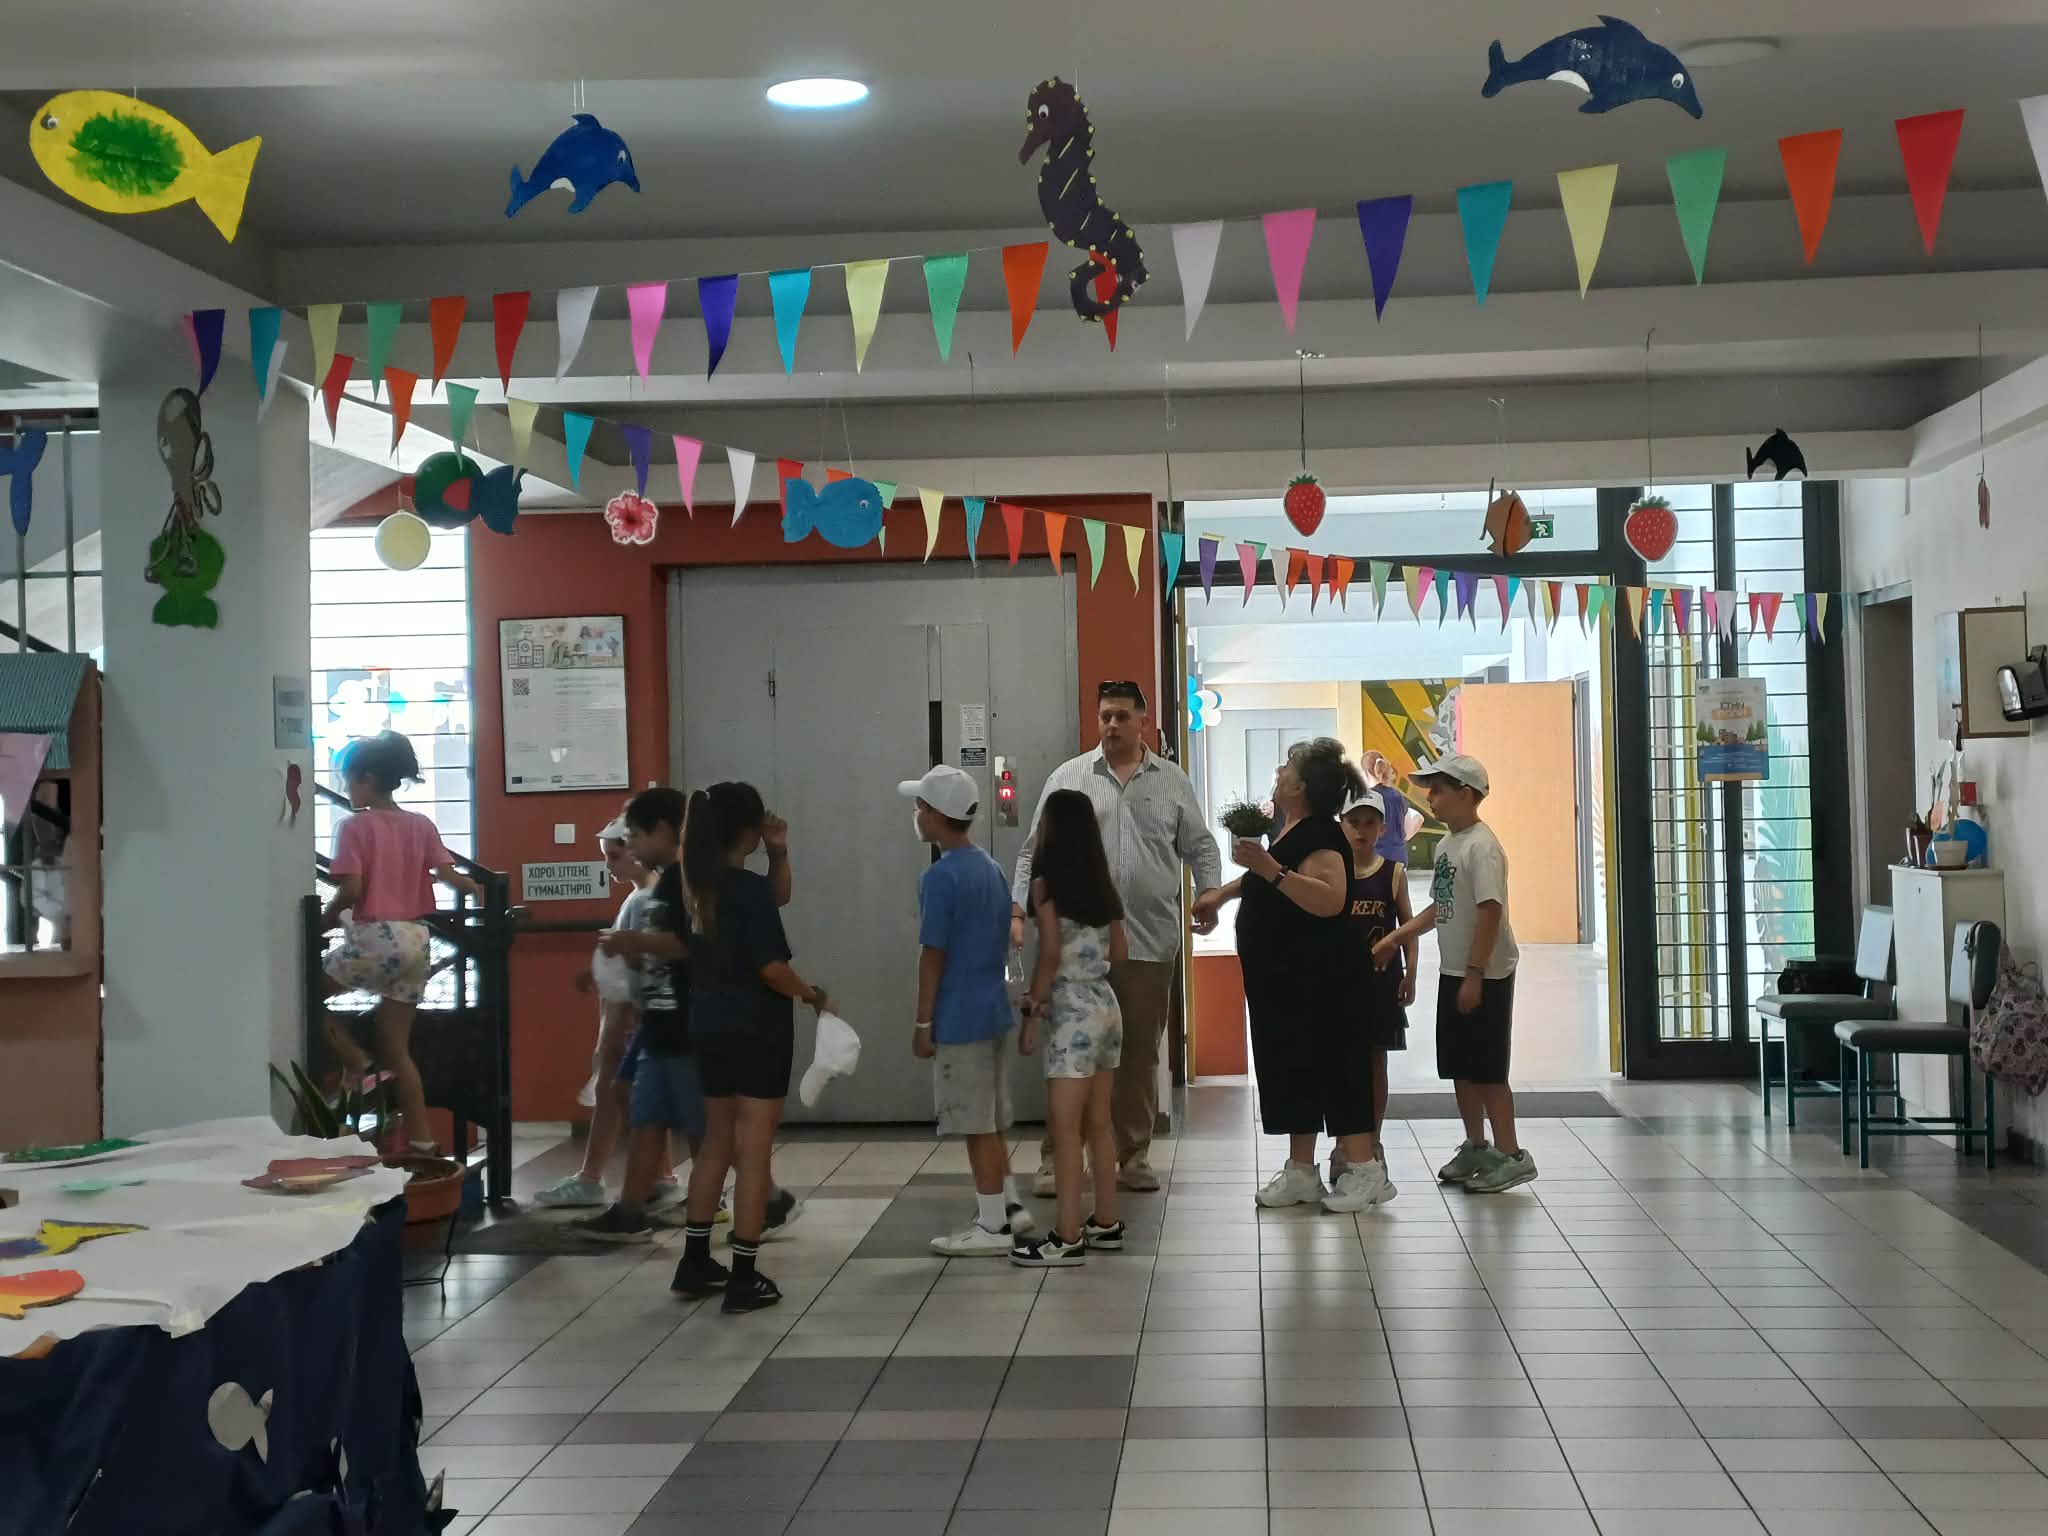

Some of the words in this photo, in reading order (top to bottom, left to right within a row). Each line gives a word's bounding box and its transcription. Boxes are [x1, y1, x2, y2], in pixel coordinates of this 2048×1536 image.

[528, 866, 555, 879] ΧΩΡΟΙ
[558, 865, 592, 878] ΣΙΤΙΣΗΣ
[527, 883, 592, 897] ΓΥΜΝΑΣΤΗΡΙΟ
